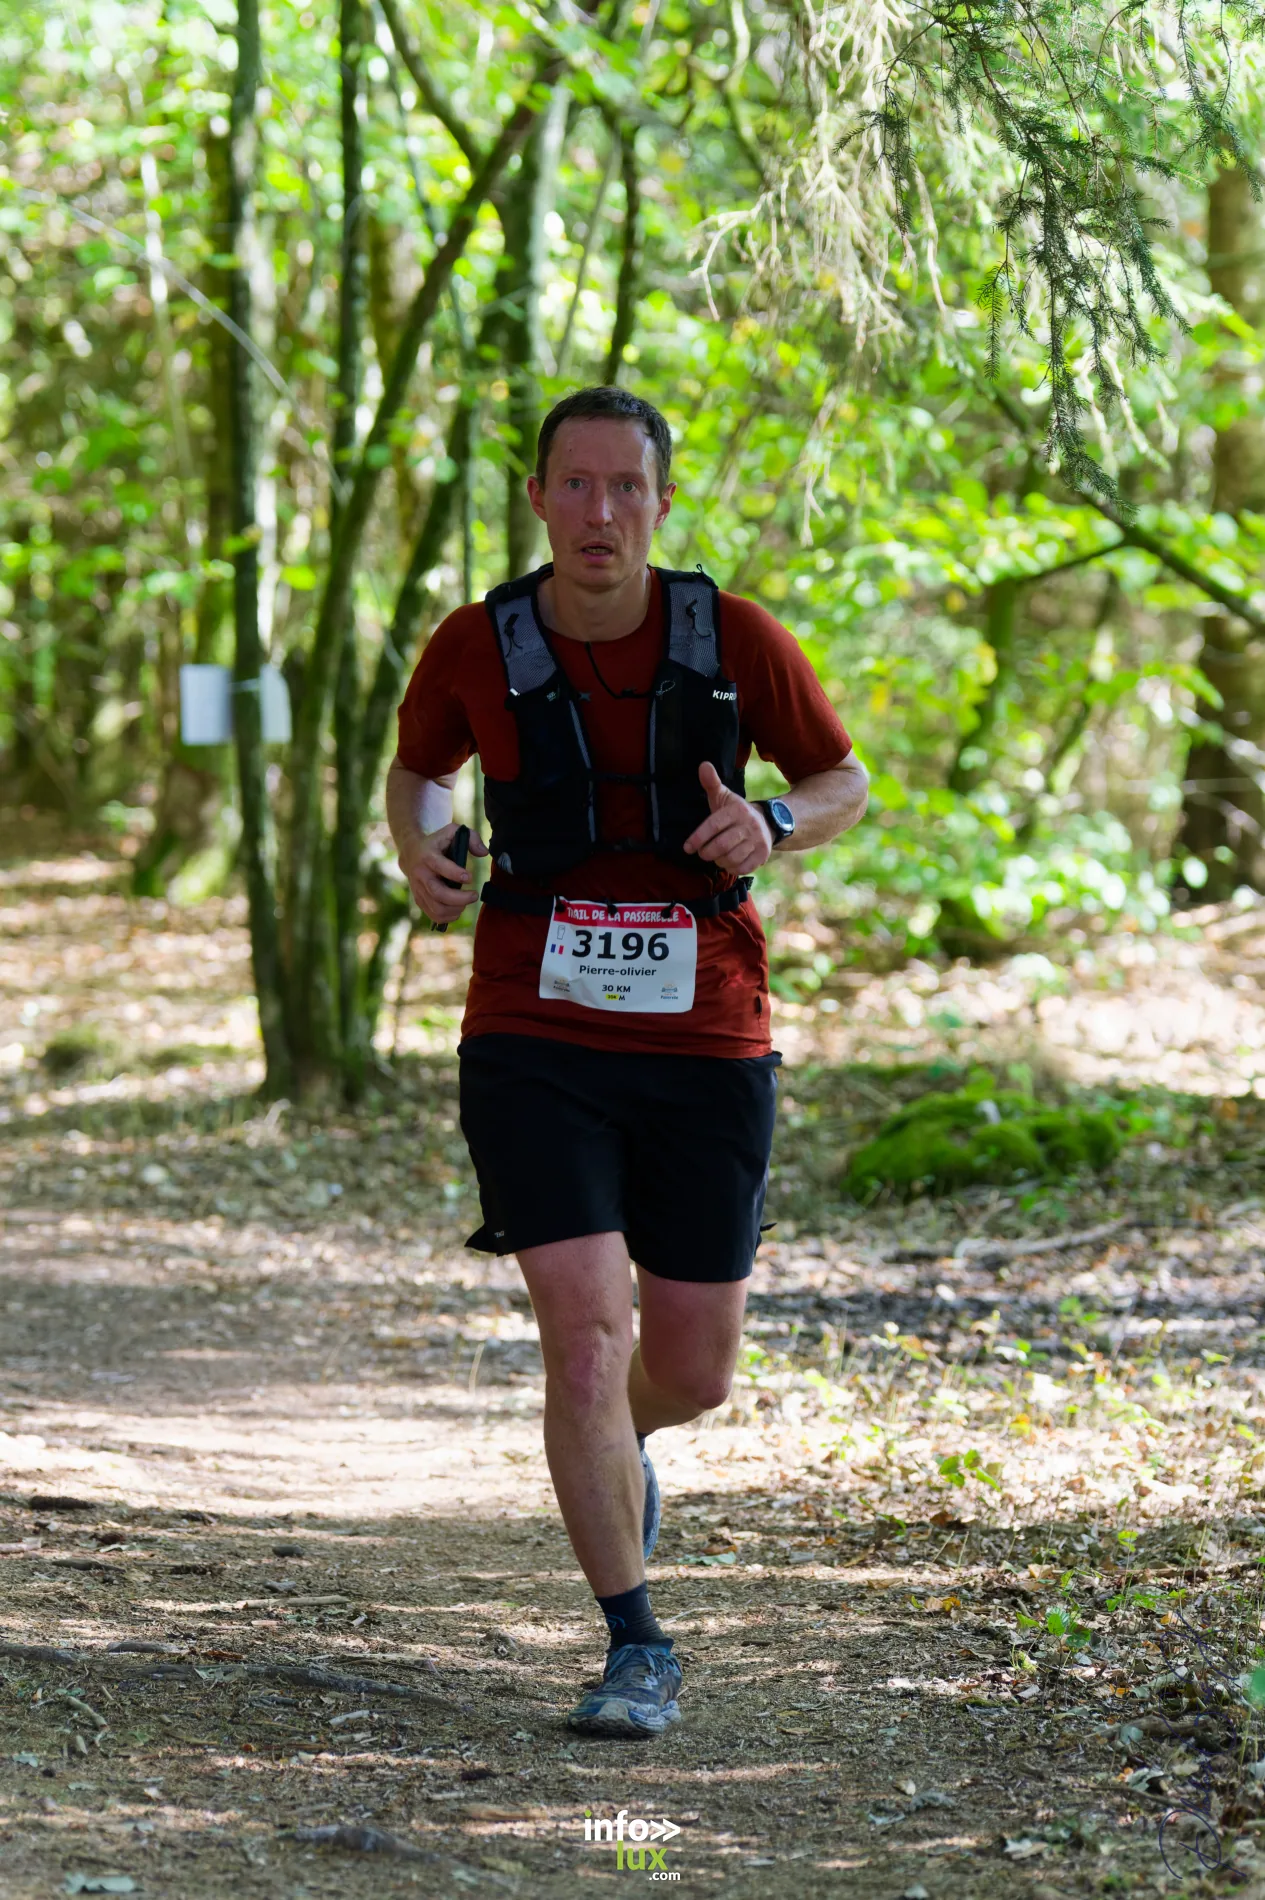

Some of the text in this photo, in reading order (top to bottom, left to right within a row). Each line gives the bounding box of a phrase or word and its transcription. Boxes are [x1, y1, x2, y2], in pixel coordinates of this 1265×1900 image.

[592, 909, 606, 920] DE
[572, 930, 670, 961] 3196
[579, 965, 657, 976] Pierre-olivier
[602, 984, 631, 993] 30 KM
